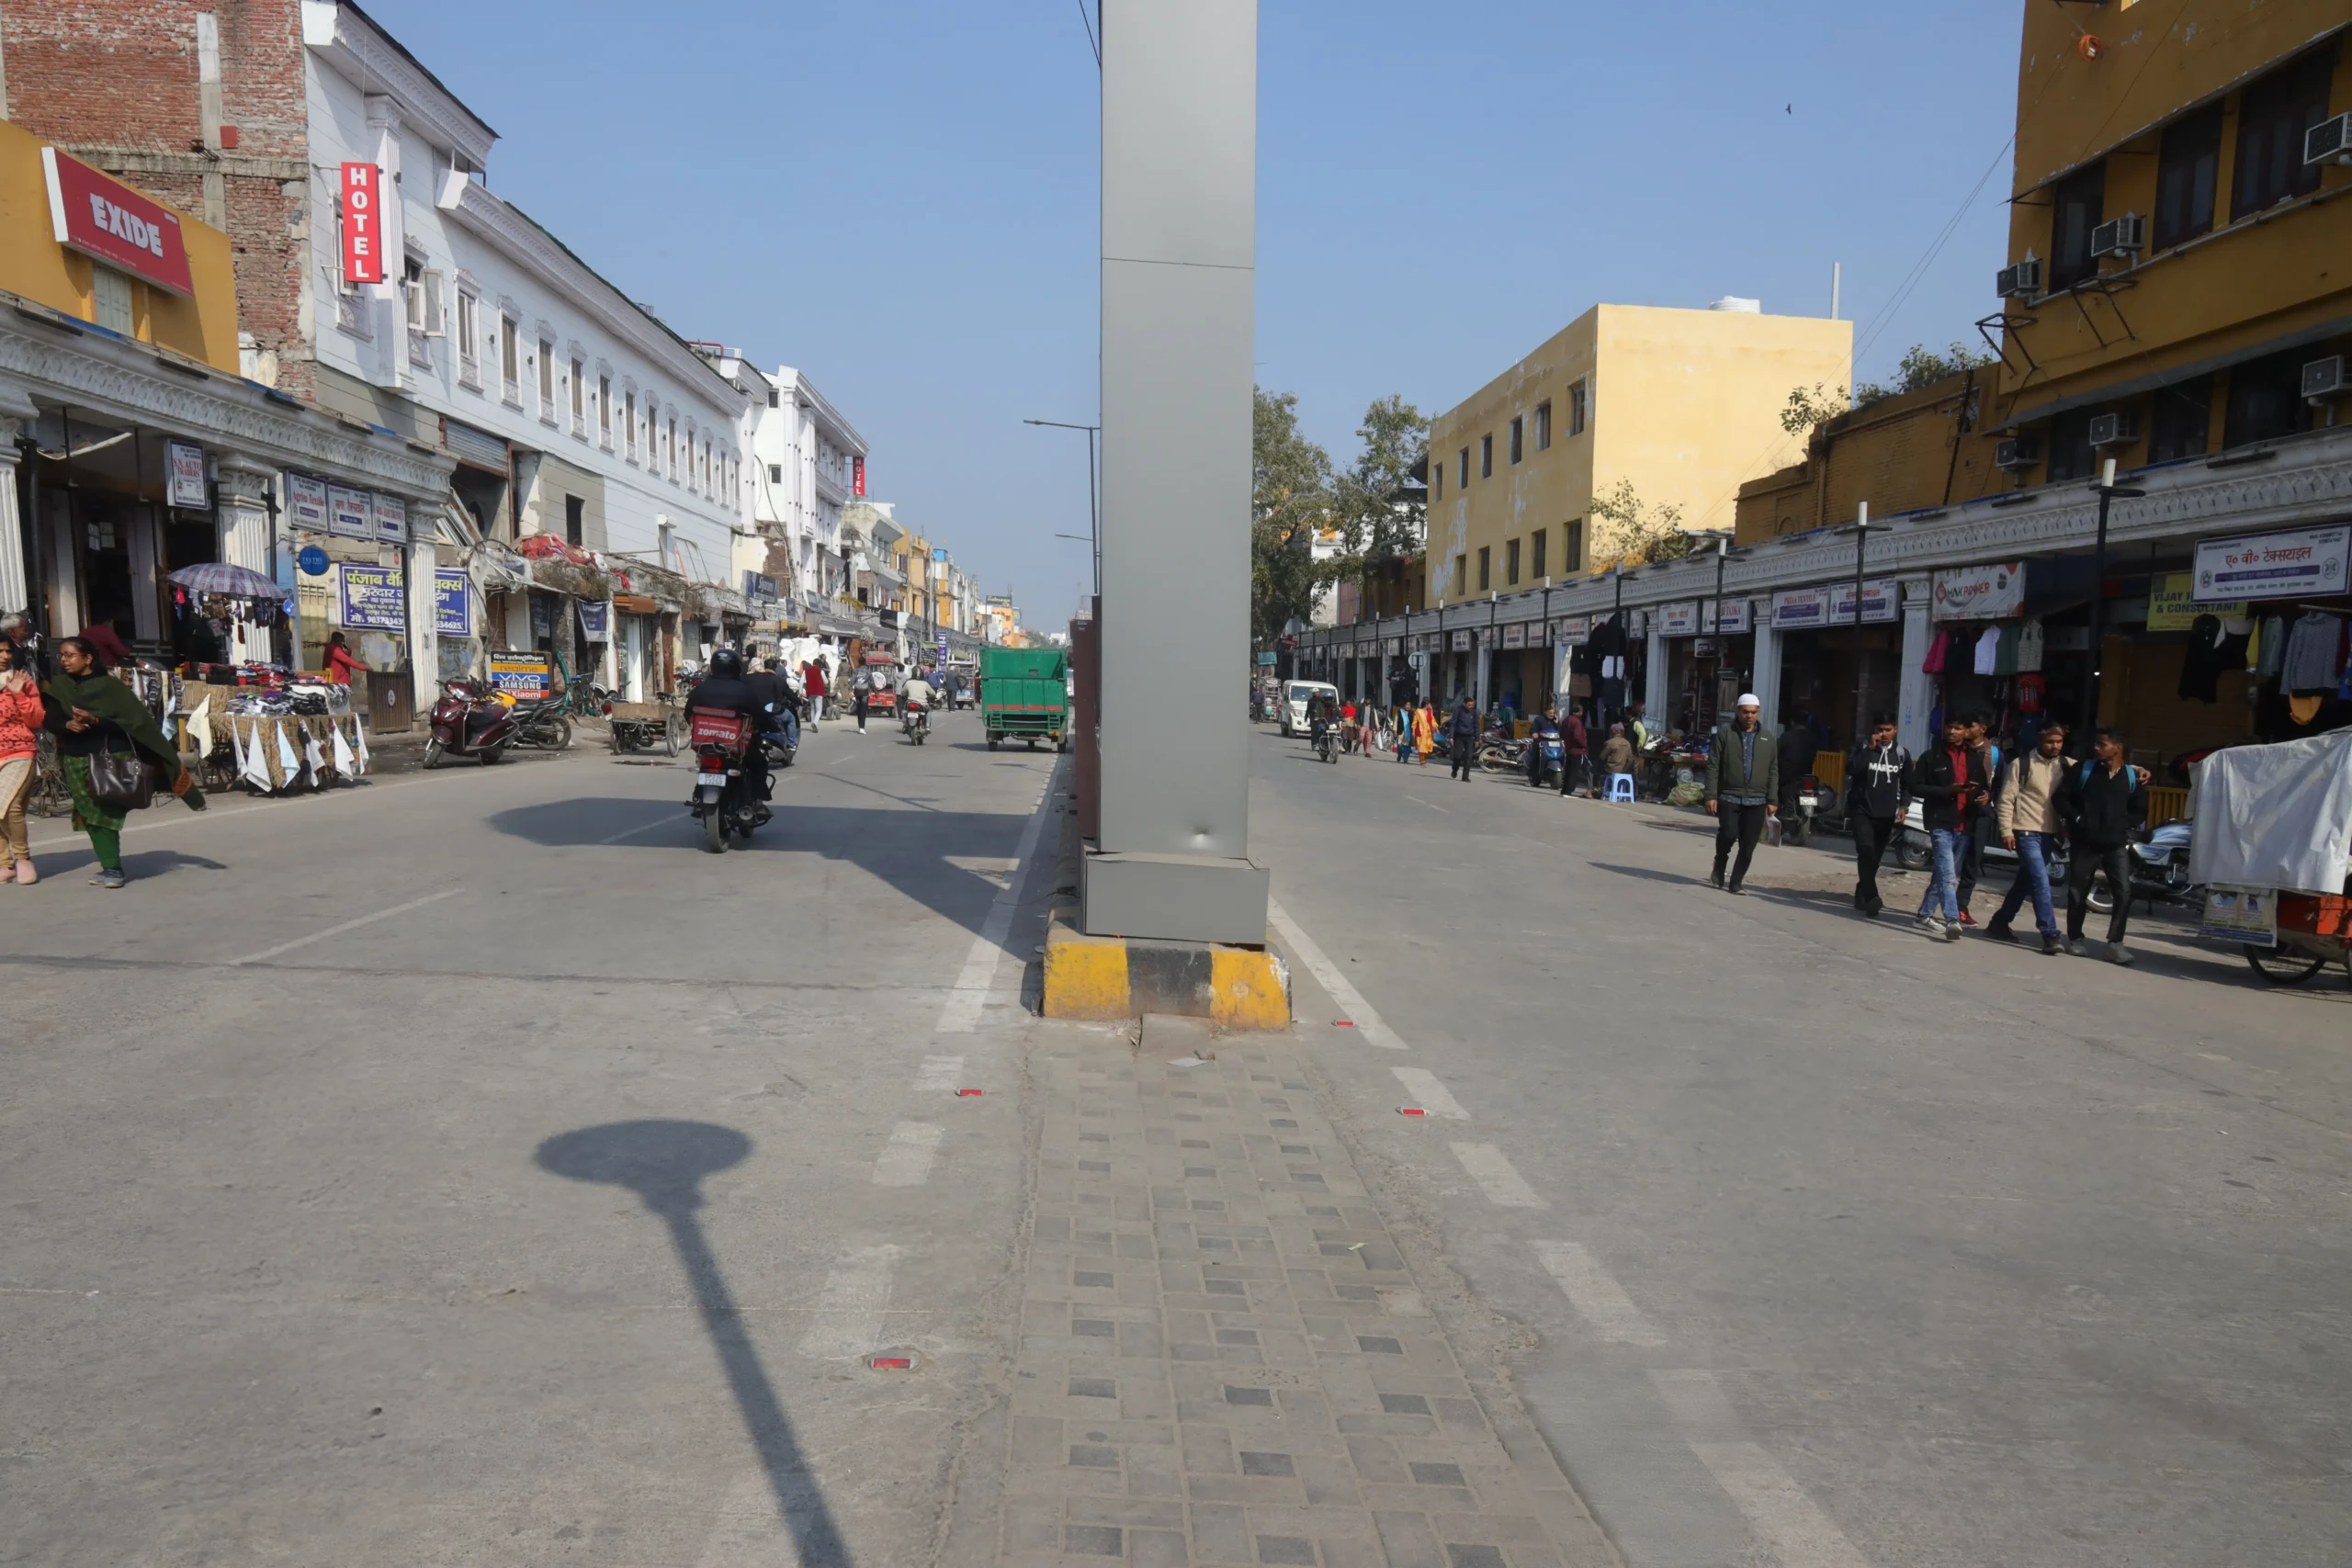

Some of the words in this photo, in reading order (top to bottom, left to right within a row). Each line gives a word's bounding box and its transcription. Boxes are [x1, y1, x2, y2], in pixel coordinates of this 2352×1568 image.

[89, 192, 164, 258] EXIDE
[350, 167, 369, 278] HOTEL
[345, 570, 383, 585] पंजाब
[2154, 592, 2183, 603] VIJAY
[499, 672, 540, 682] vivo
[499, 681, 541, 690] SAMSUNG
[697, 728, 736, 740] zomato
